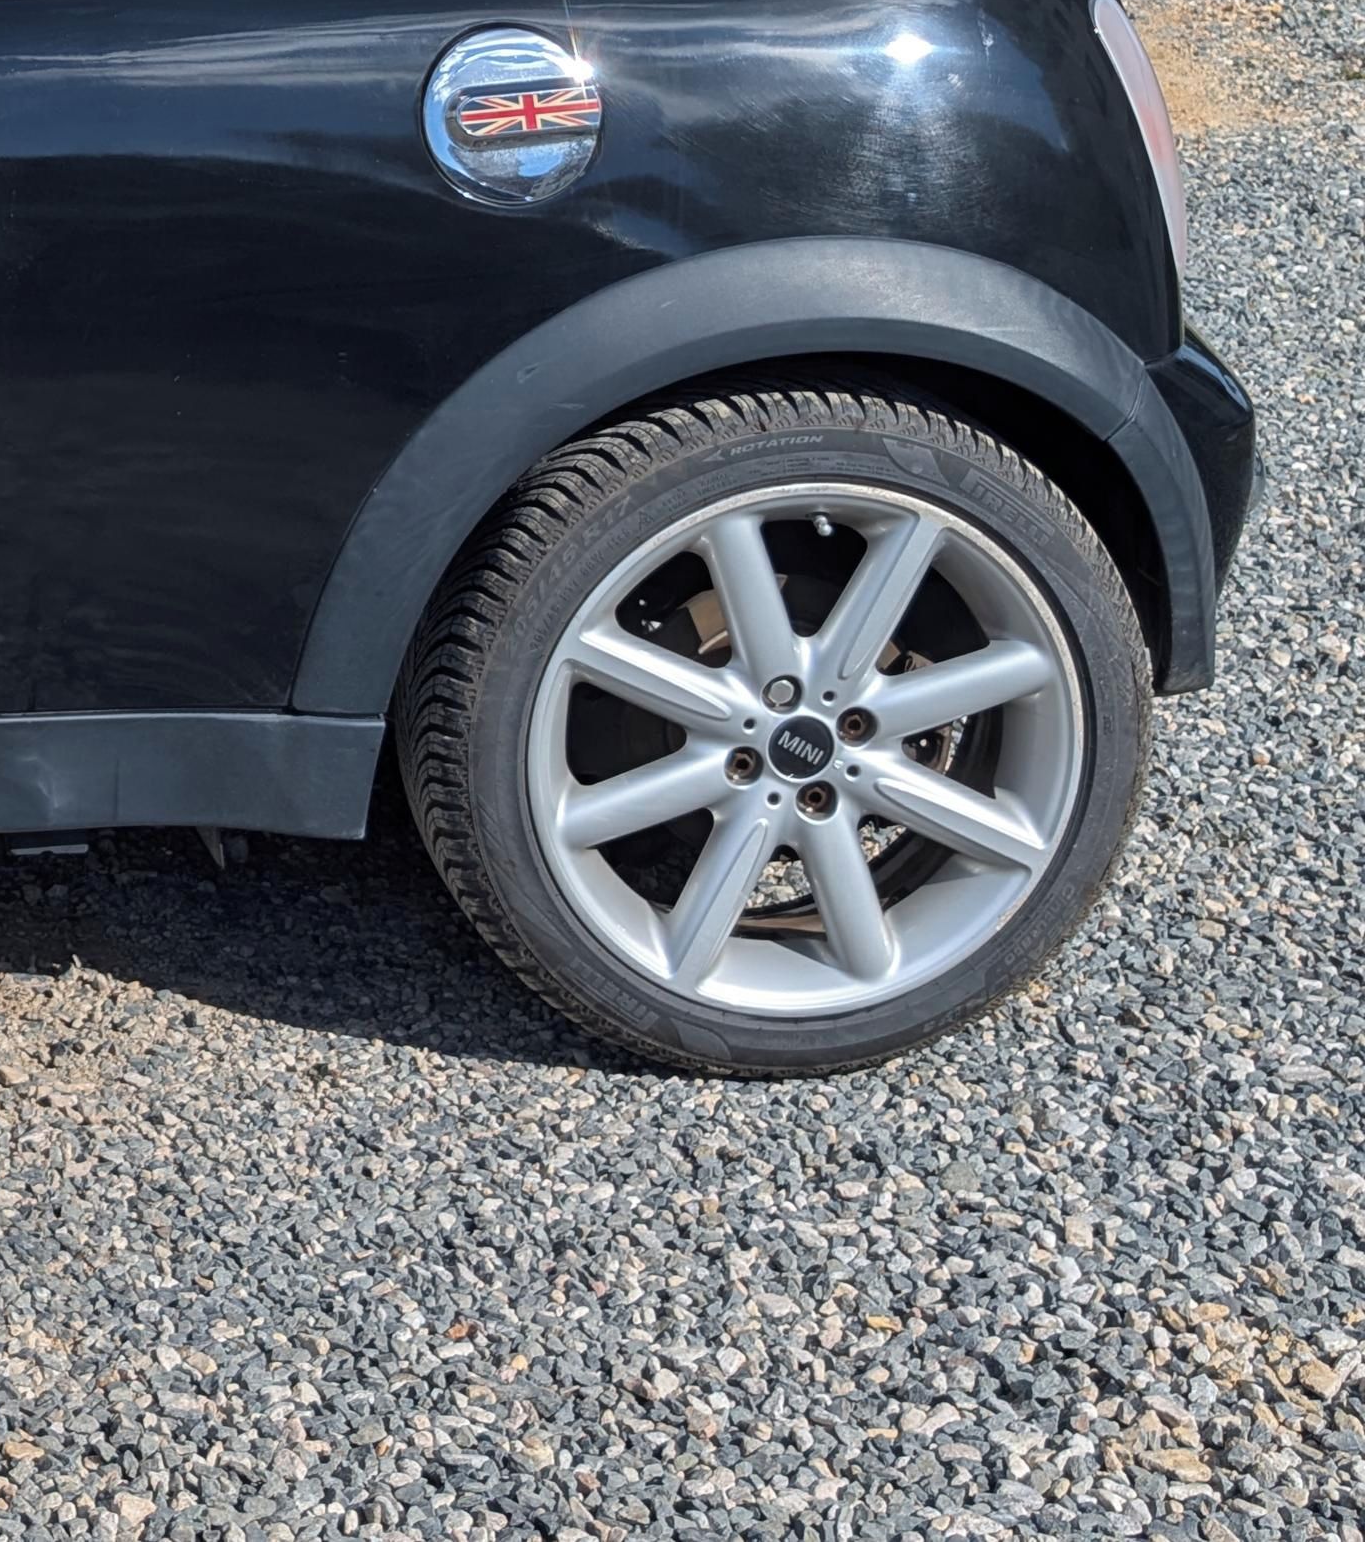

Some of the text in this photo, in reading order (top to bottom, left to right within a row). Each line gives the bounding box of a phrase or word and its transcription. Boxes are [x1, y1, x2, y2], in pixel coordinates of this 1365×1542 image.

[730, 434, 824, 457] ROTATION
[958, 466, 1056, 547] PIRELLI
[777, 730, 825, 766] MINI
